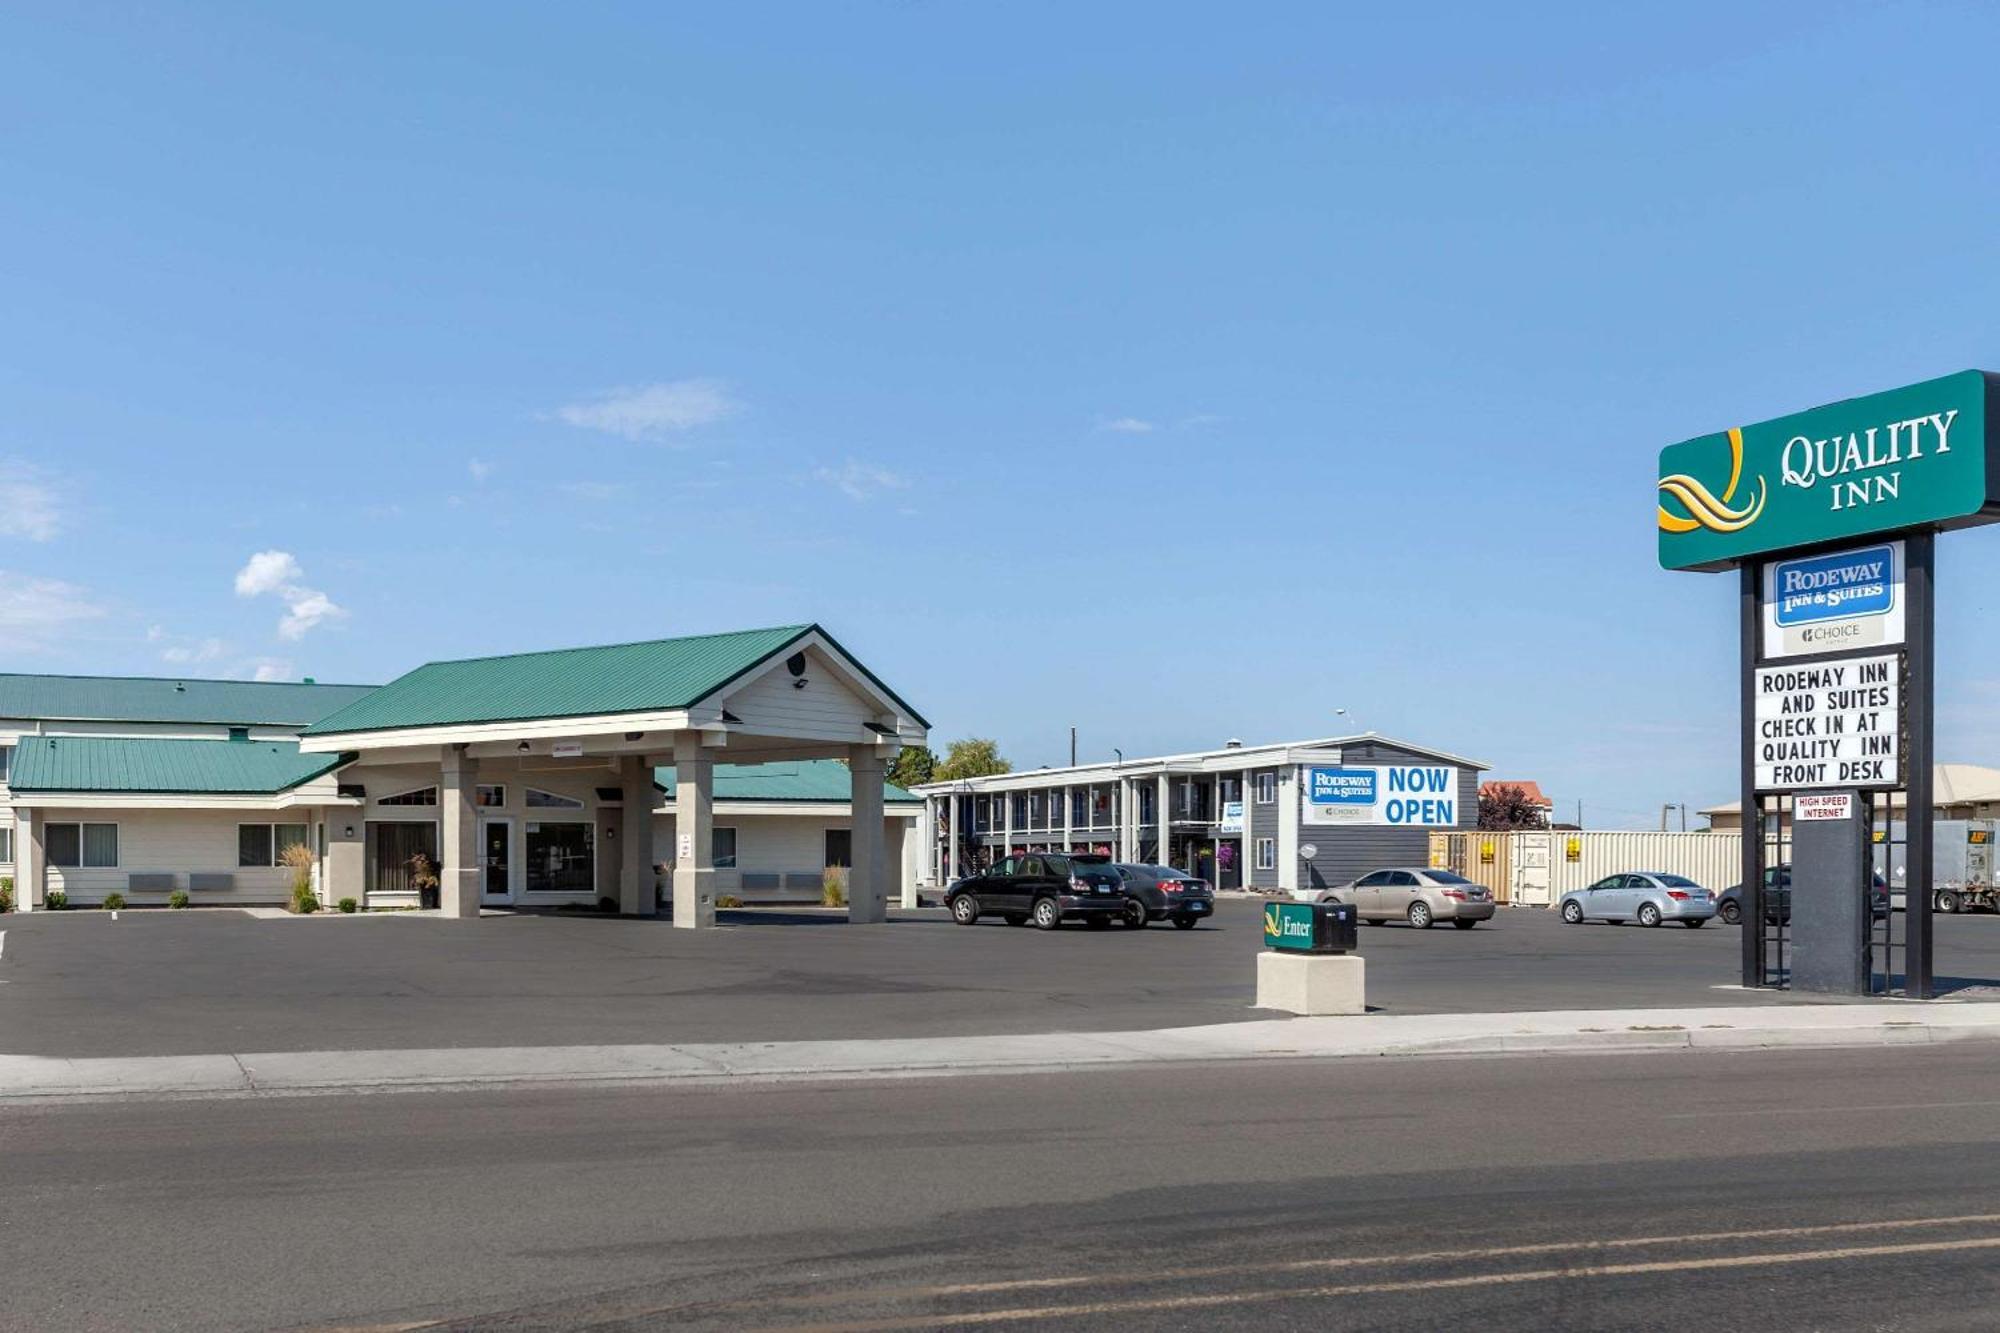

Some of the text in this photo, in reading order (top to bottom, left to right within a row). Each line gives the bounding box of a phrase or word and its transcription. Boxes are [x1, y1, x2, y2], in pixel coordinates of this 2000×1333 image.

[1782, 409, 1958, 488] QUALITY
[1830, 472, 1900, 511] INN
[1784, 562, 1883, 593] RODEWAY
[1783, 582, 1884, 613] INN & SUITES
[1814, 624, 1860, 640] CHOICE
[1763, 662, 1888, 693] RODEWAY INN
[1781, 687, 1889, 714] AND SUITES
[1761, 712, 1879, 738] CHECK IN AT
[1763, 735, 1891, 761] QUALITY INN
[1315, 772, 1372, 786] RODEWAY
[1388, 768, 1449, 793] NOW
[1773, 760, 1883, 784] FRONT DESK
[1315, 787, 1332, 797] INN
[1341, 787, 1373, 798] SUITES
[1799, 796, 1848, 806] HIGH SPEED
[1385, 799, 1453, 824] OPEN
[1803, 808, 1844, 818] INTERNET
[1283, 916, 1311, 937] Enter
